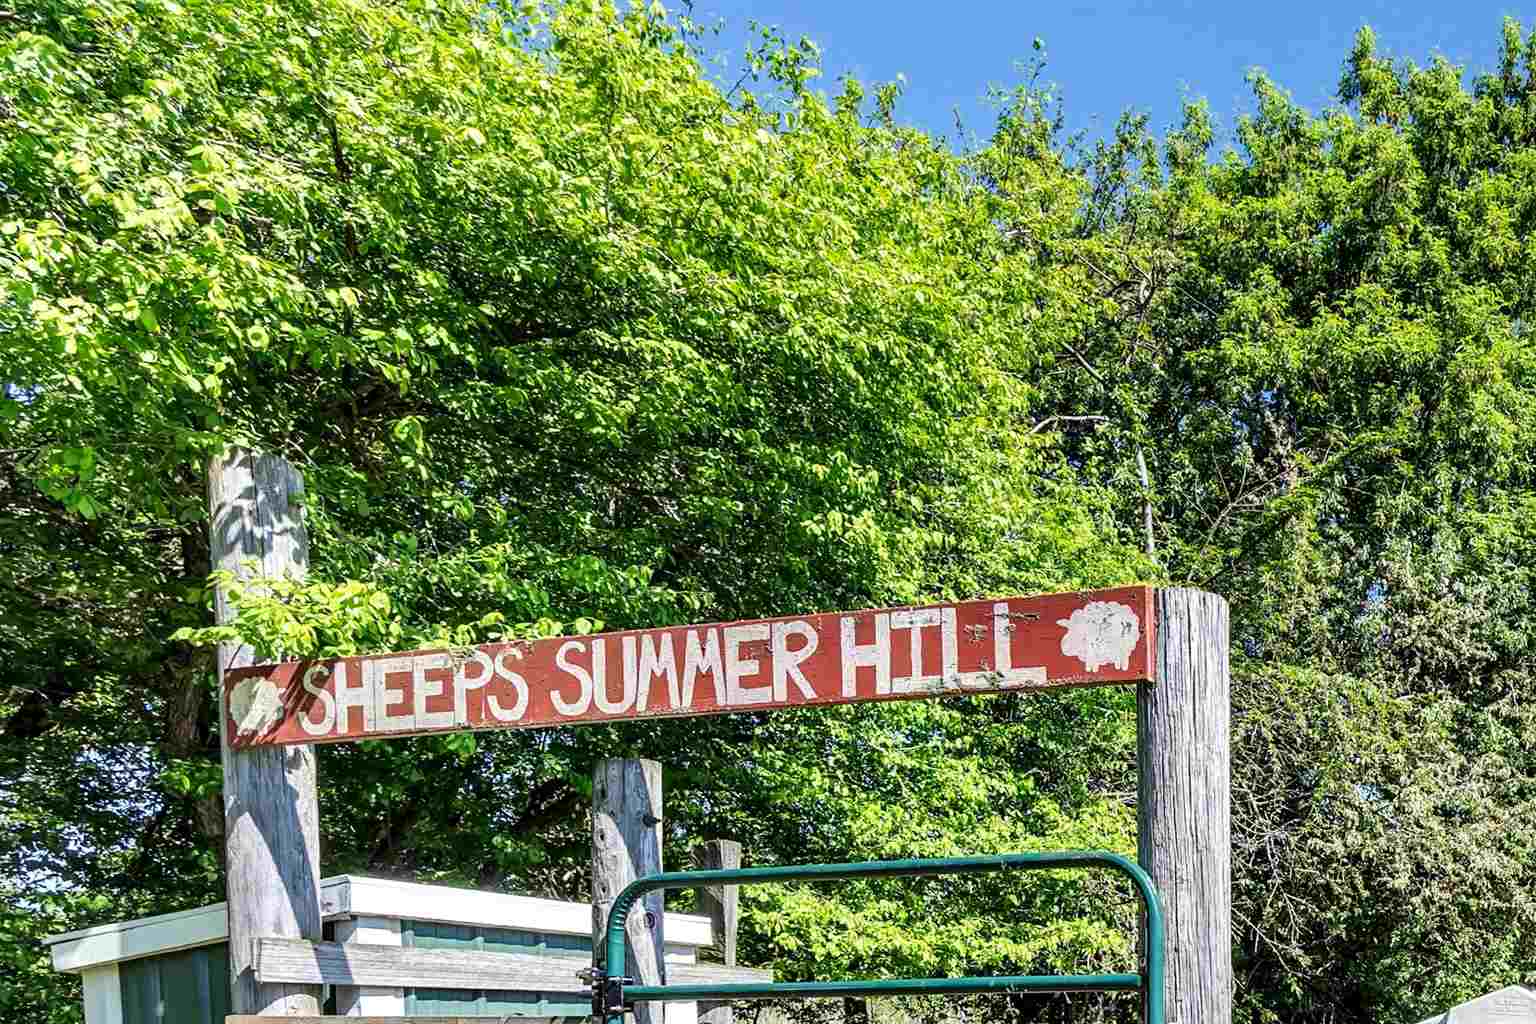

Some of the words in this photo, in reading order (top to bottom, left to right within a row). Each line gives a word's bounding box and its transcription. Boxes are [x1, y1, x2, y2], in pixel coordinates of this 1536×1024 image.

[298, 646, 529, 736] SHEEPS
[549, 620, 818, 716] SUMMER
[840, 602, 1048, 698] HILL
